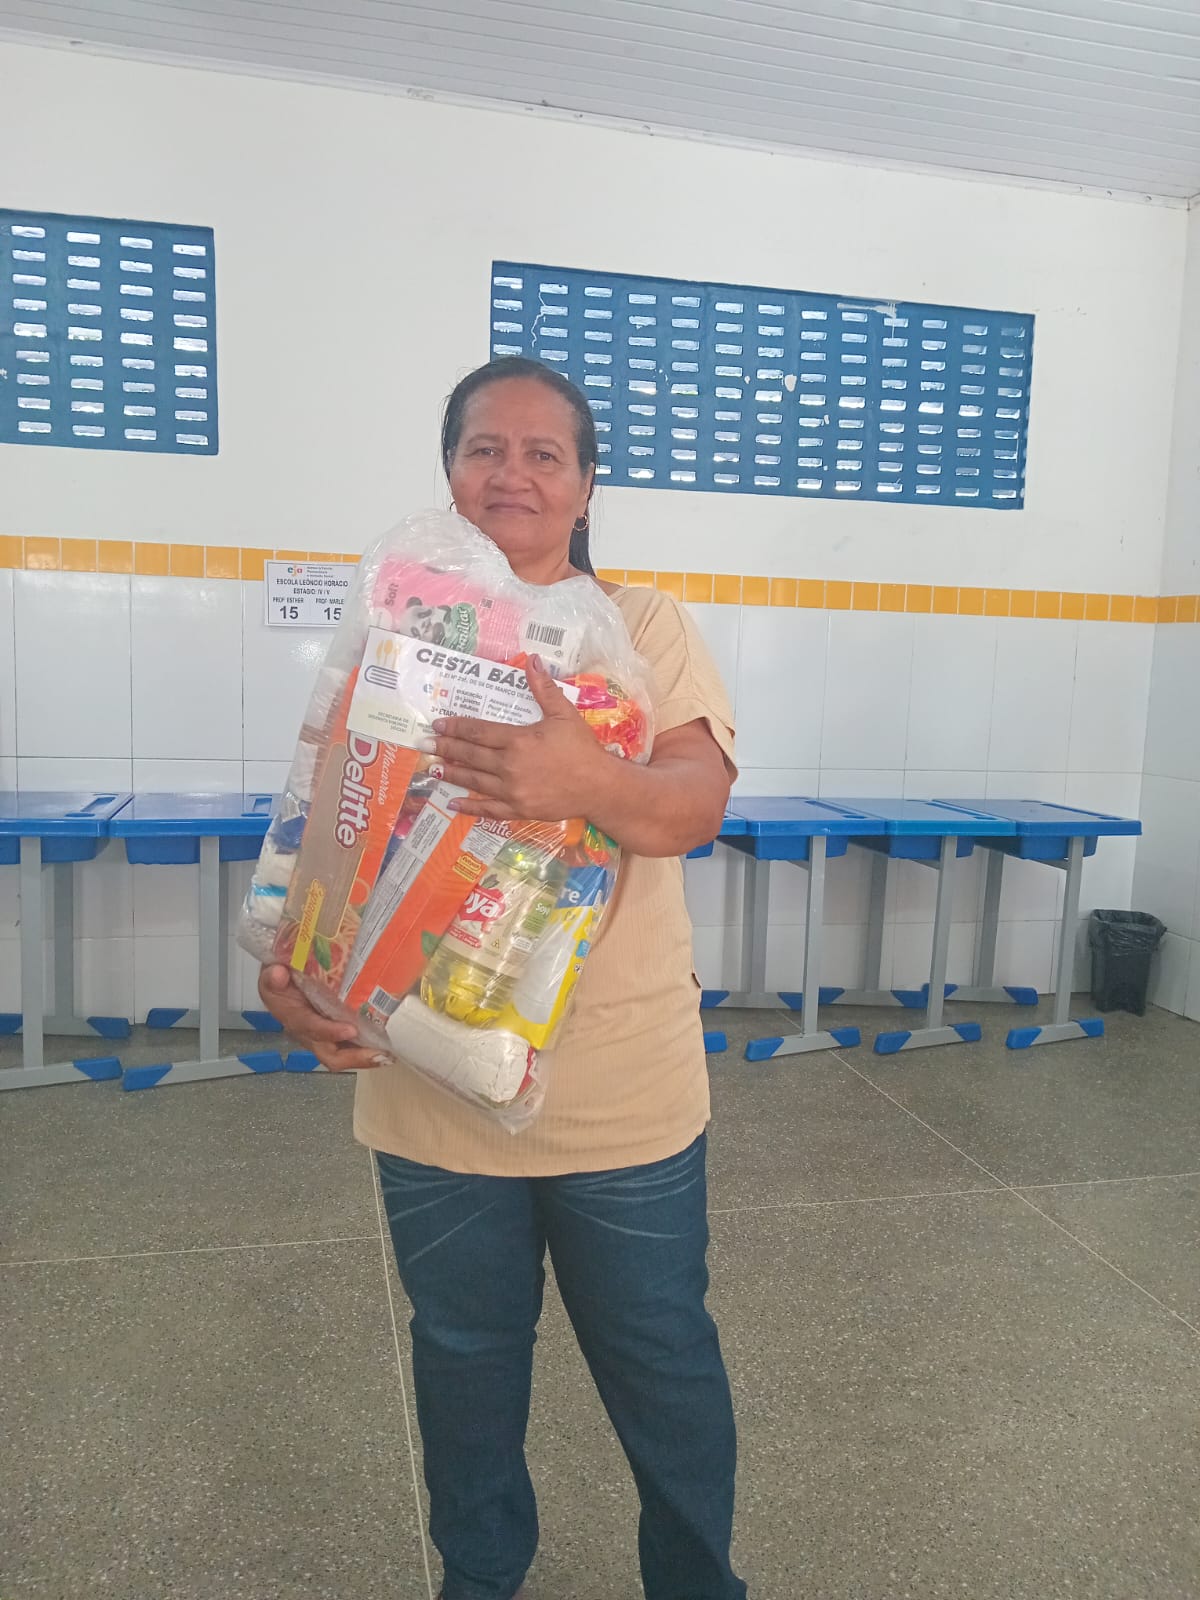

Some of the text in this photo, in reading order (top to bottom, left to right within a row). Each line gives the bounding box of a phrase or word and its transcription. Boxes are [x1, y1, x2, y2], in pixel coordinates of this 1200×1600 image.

[287, 565, 303, 577] eja
[276, 578, 298, 586] ESCOLA
[384, 582, 399, 607] Soft
[279, 605, 299, 620] 15
[323, 607, 342, 620] 15
[416, 648, 480, 677] CESTA
[487, 667, 533, 692] BÁS
[485, 682, 494, 690] DE
[495, 685, 516, 696] MARÇO
[439, 708, 458, 718] ETAPA
[337, 730, 379, 846] Delitte
